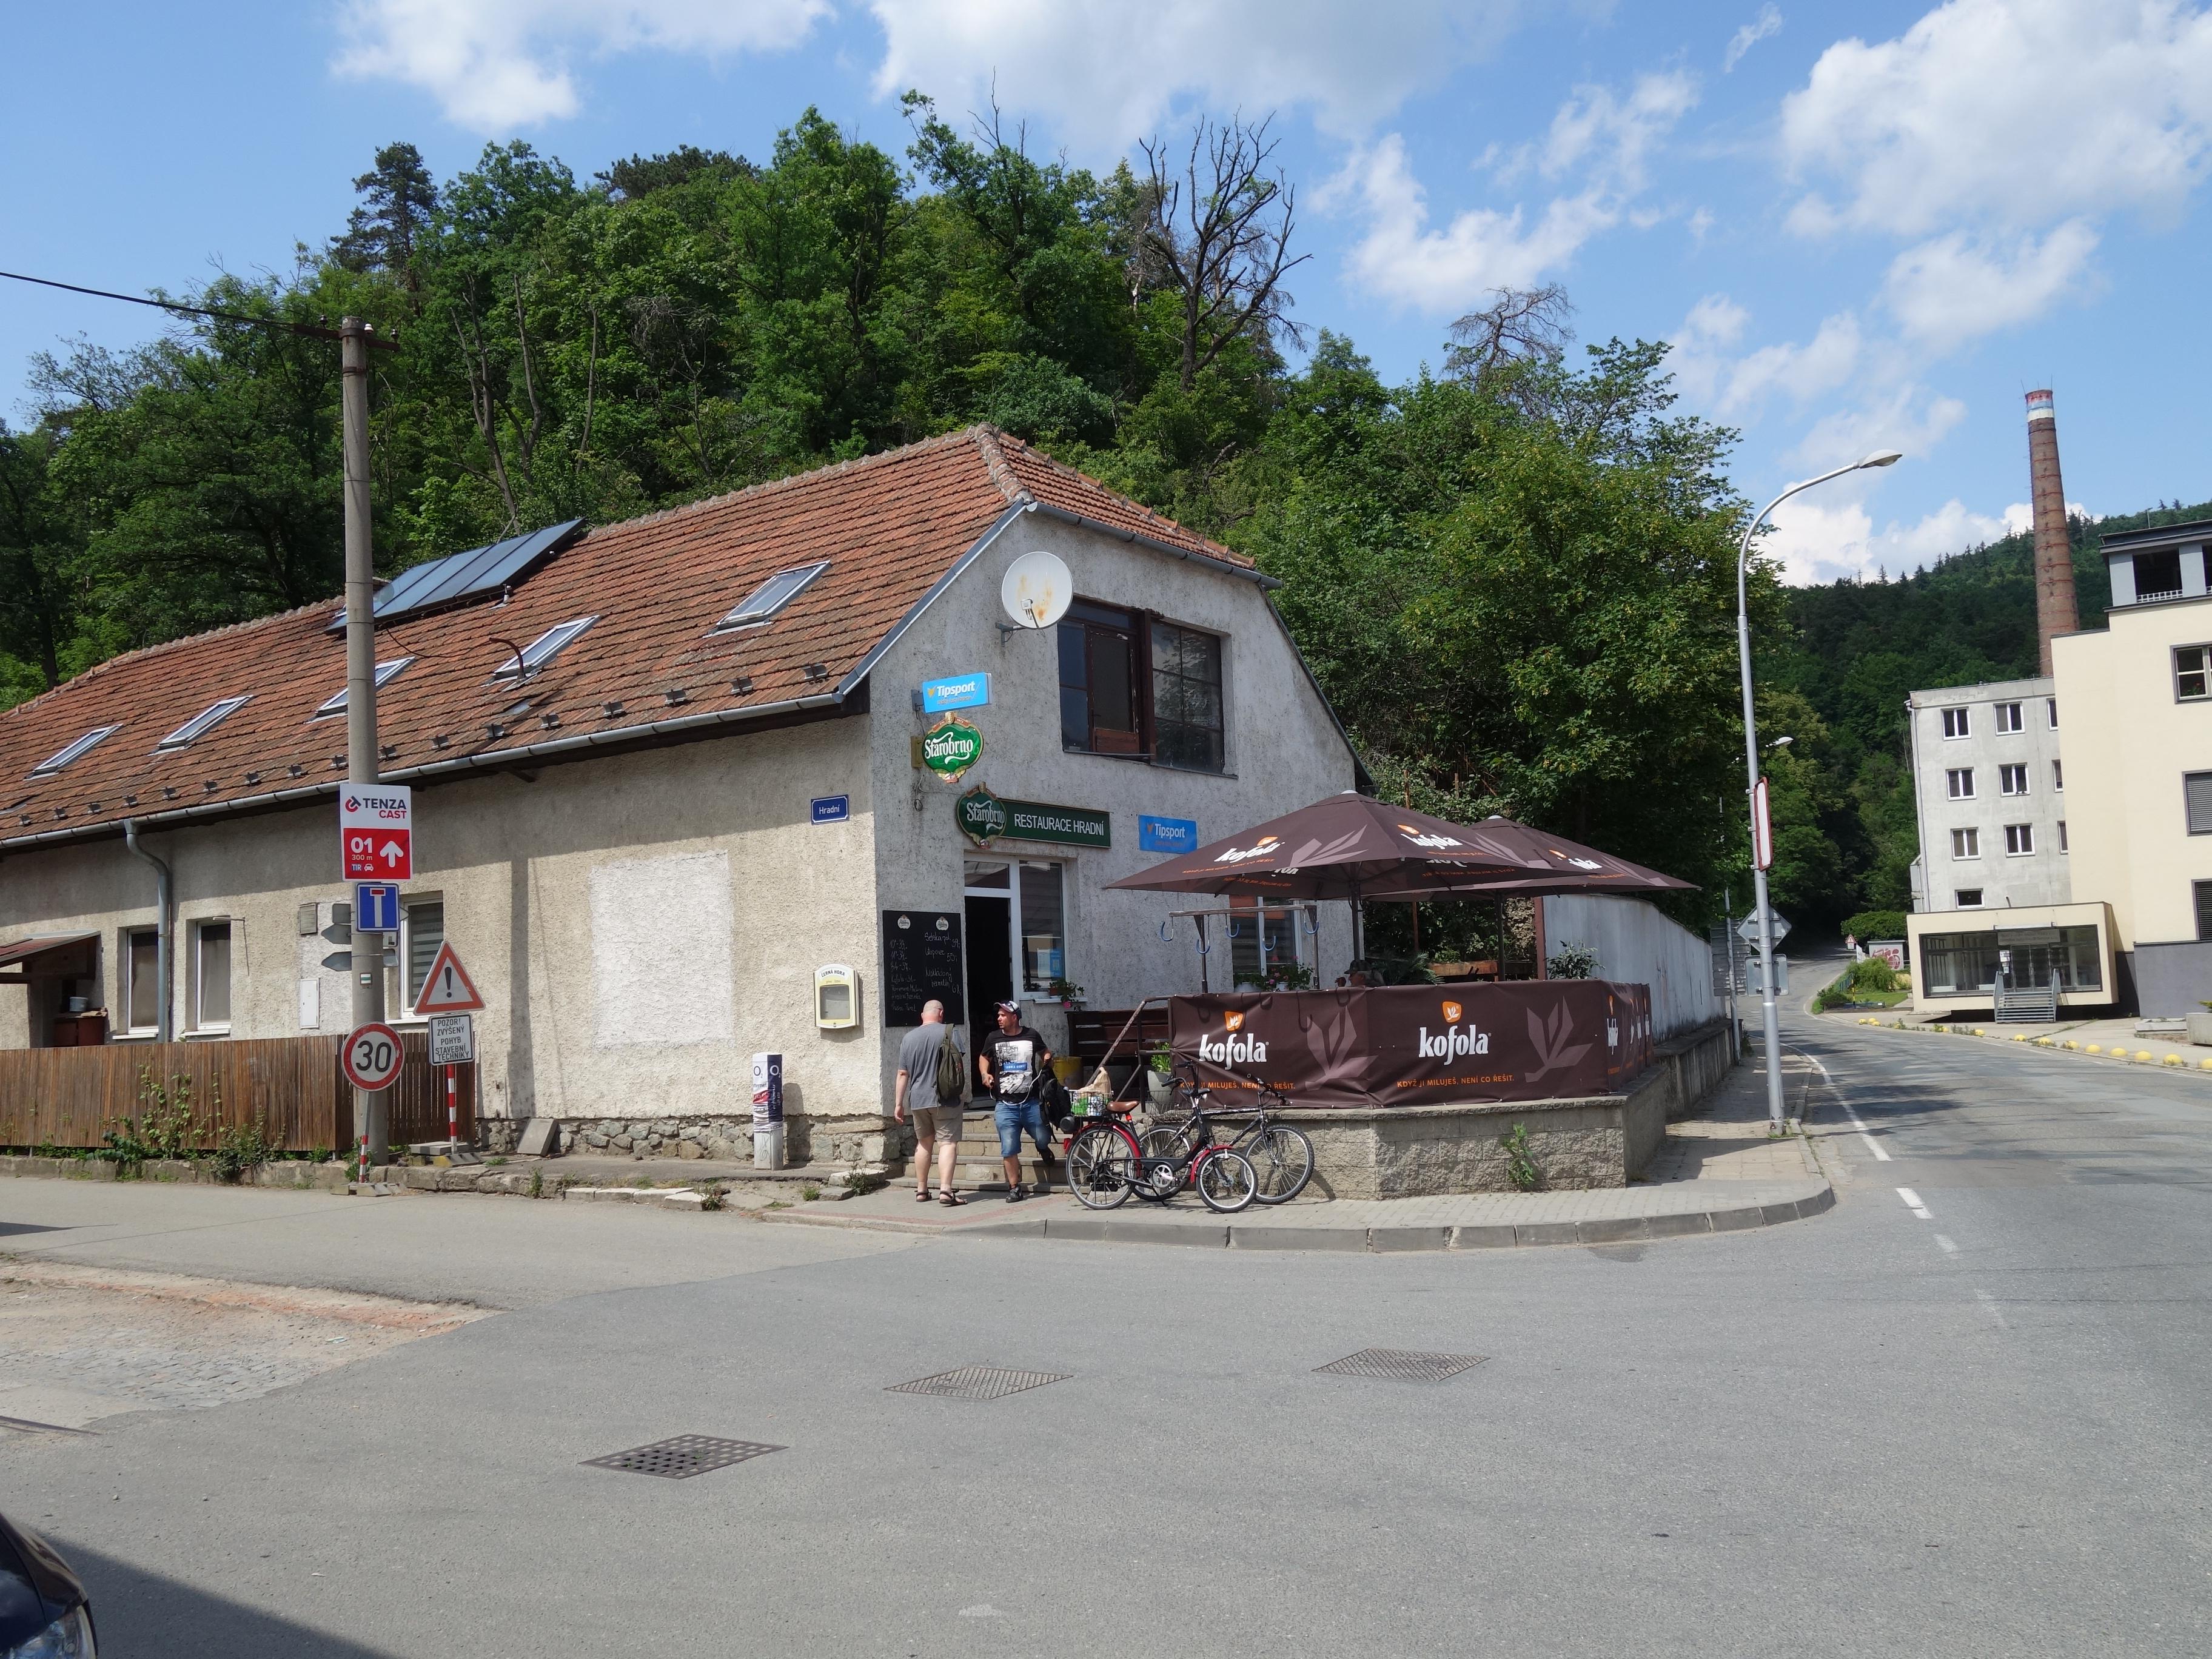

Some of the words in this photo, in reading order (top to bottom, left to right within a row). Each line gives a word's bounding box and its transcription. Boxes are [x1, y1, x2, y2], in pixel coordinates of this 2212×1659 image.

[937, 680, 975, 697] Tipsport
[925, 732, 973, 765] Starobrno
[363, 798, 407, 809] TENZA
[819, 804, 840, 815] Hradní
[379, 809, 407, 819] CAST
[967, 800, 1005, 834] Starobrno
[1014, 813, 1071, 833] RESTAURACE
[1073, 820, 1104, 836] HRADNÍ
[1155, 823, 1185, 839] Tipsport
[350, 837, 373, 853] 01
[1214, 842, 1281, 863] kofola
[437, 1024, 464, 1036] ZVÝŠENÝ
[438, 1018, 461, 1027] POZOR!
[441, 1036, 461, 1045] POHYB
[1418, 1024, 1489, 1065] kofola
[435, 1043, 466, 1054] STAVEBNÍ
[438, 1051, 469, 1061] TECHNIKY
[1199, 1033, 1267, 1070] kofola
[356, 1040, 392, 1073] 30
[1208, 1080, 1239, 1089] MILUJEŠ,
[1397, 1079, 1417, 1088] KDYŽ
[1427, 1077, 1459, 1086] MILUJEŠ,
[1461, 1075, 1478, 1084] NENÍ
[1493, 1074, 1515, 1082] ŘEŠIT.
